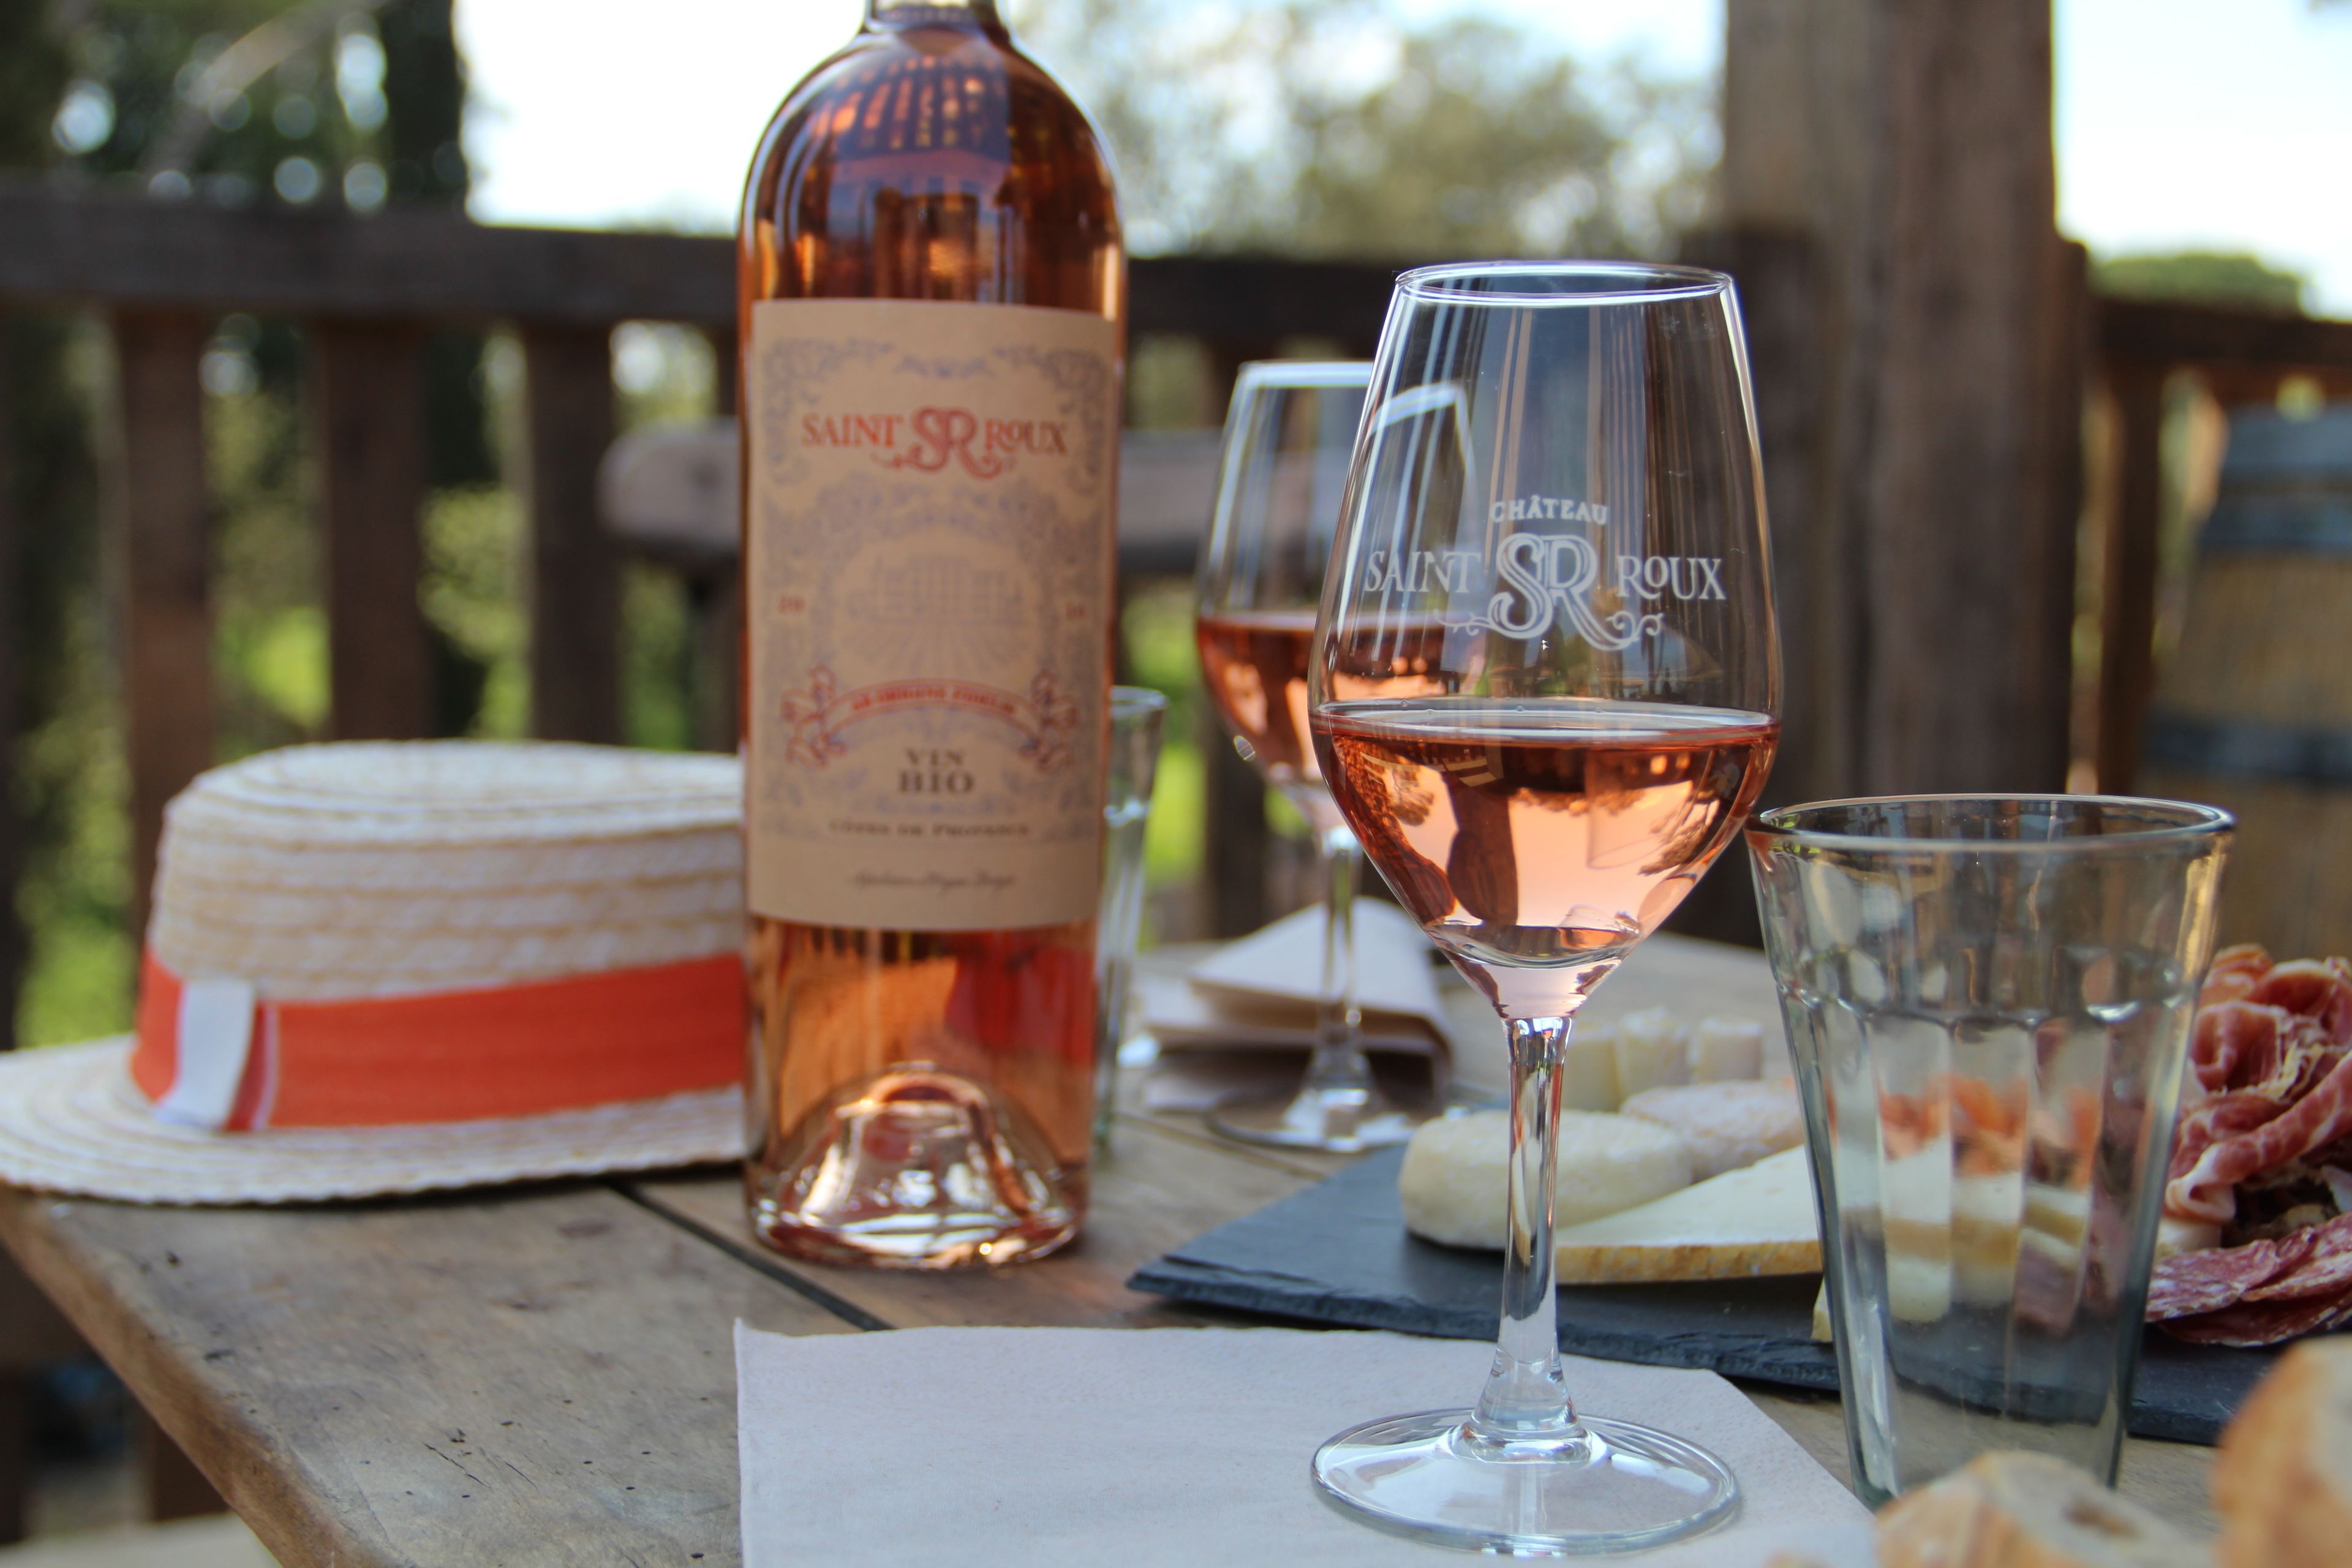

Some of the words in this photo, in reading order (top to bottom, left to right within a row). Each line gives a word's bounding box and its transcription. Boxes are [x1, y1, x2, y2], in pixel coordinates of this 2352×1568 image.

[801, 413, 903, 448] SAINT
[895, 406, 1009, 480] SR
[984, 418, 1068, 455] ROUX
[1488, 494, 1608, 526] CHÂTEAU
[1363, 550, 1481, 594] SAINT
[1477, 532, 1648, 652] SR
[1615, 554, 1727, 601] ROUX
[905, 747, 966, 767] VIN
